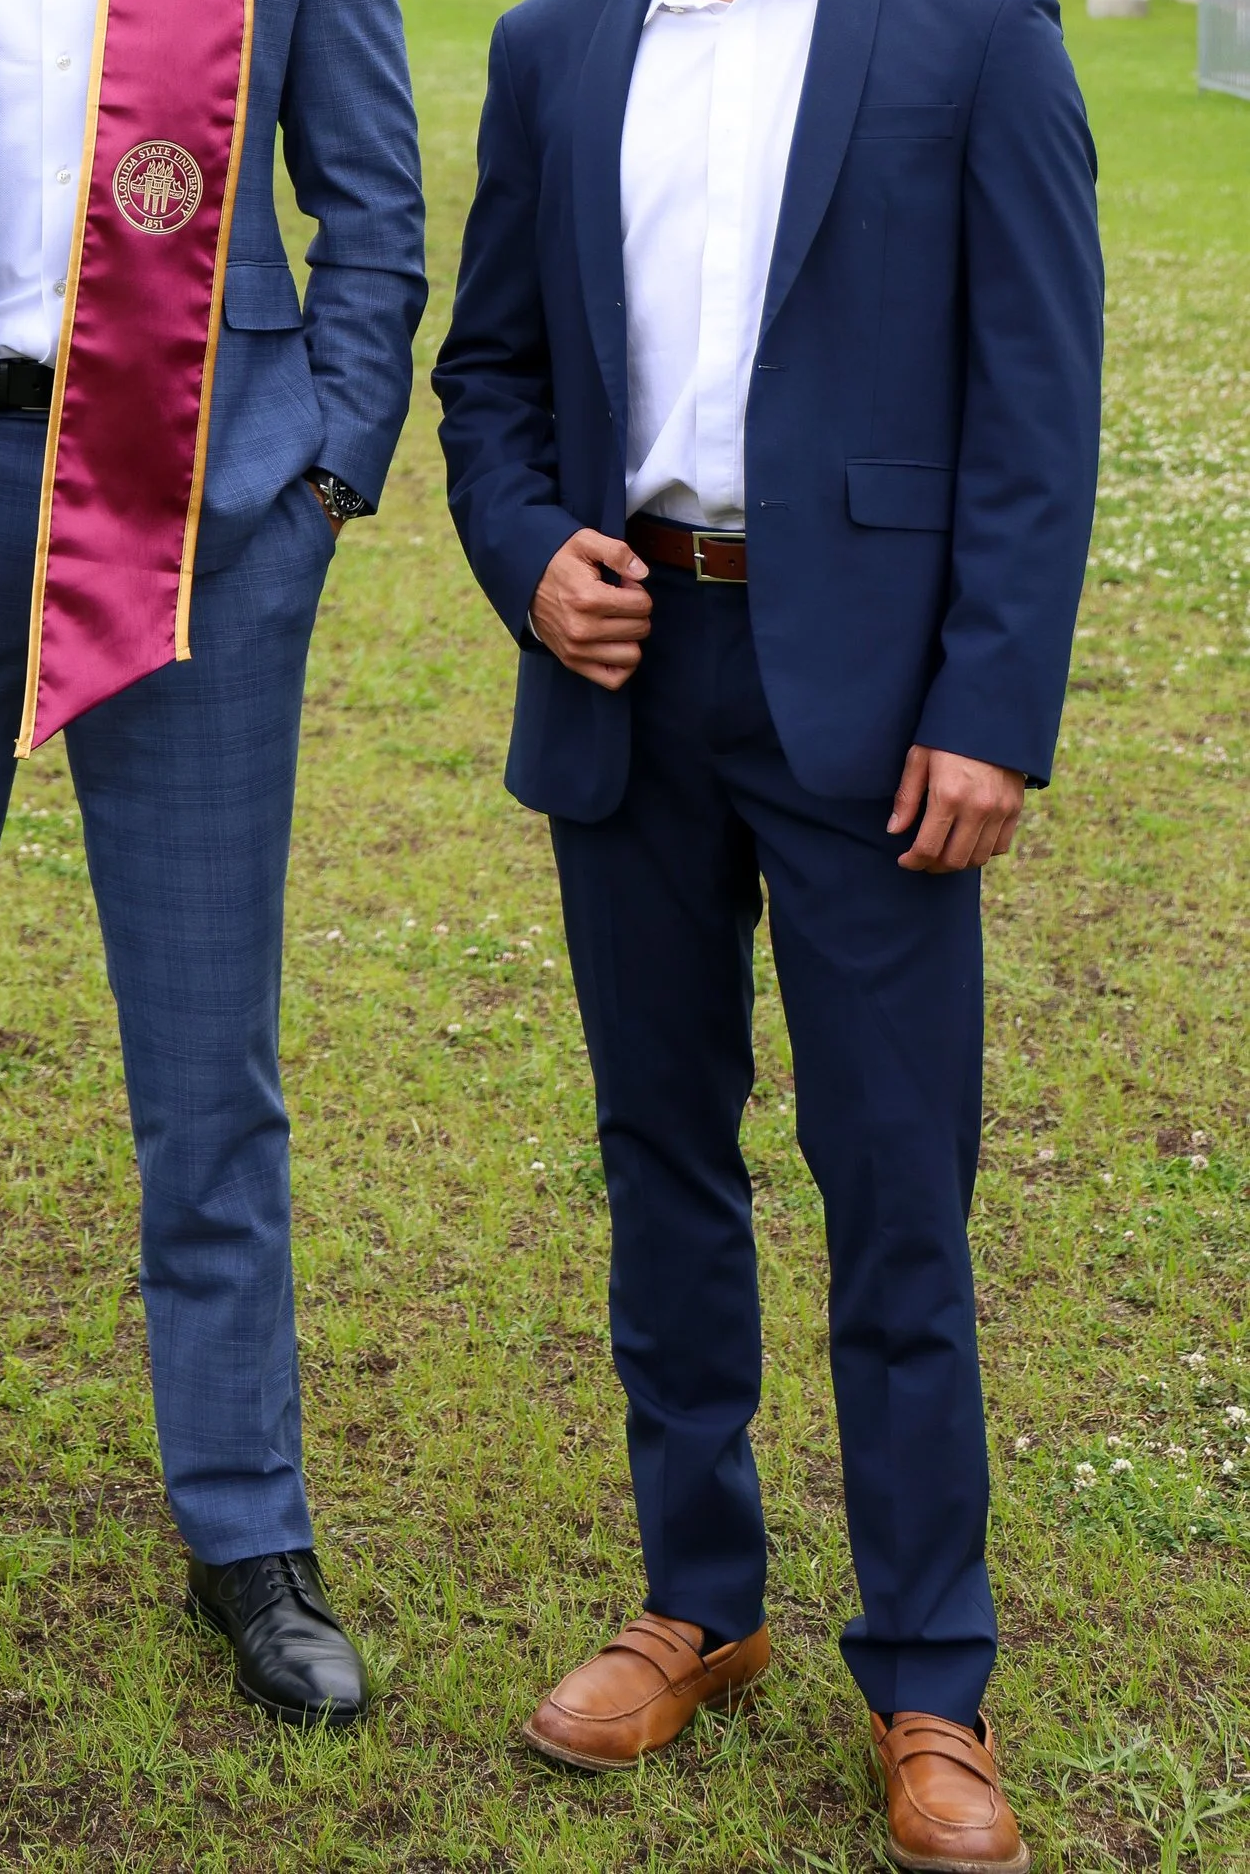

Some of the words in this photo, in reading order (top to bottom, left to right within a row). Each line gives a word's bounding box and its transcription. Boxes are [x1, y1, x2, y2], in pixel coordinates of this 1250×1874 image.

[119, 157, 139, 207] FLORIDA
[139, 146, 172, 159] STATE
[173, 152, 198, 218] UNIVERSITY
[142, 217, 164, 229] 1851
